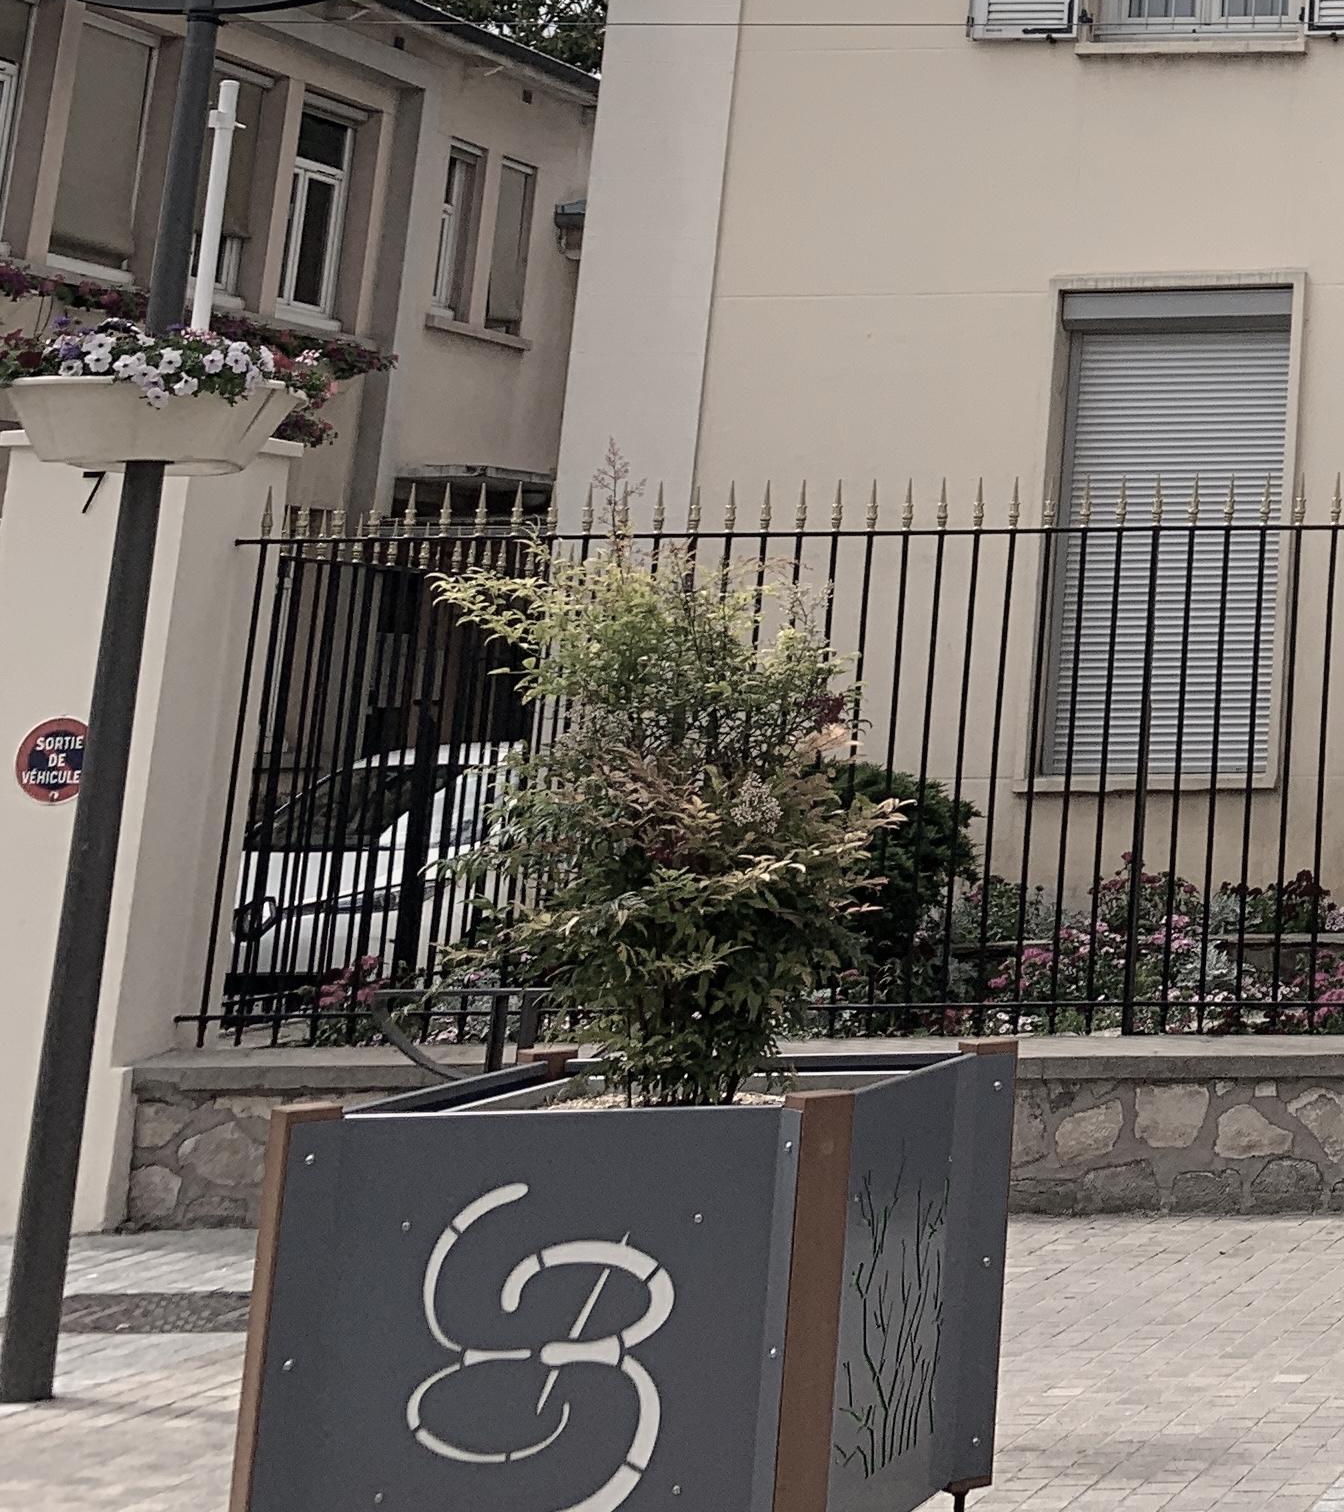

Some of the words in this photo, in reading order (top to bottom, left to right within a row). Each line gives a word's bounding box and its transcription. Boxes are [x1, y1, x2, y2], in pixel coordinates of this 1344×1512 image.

[82, 471, 106, 513] 7
[36, 735, 84, 751] SORTIE
[48, 752, 67, 767] DE
